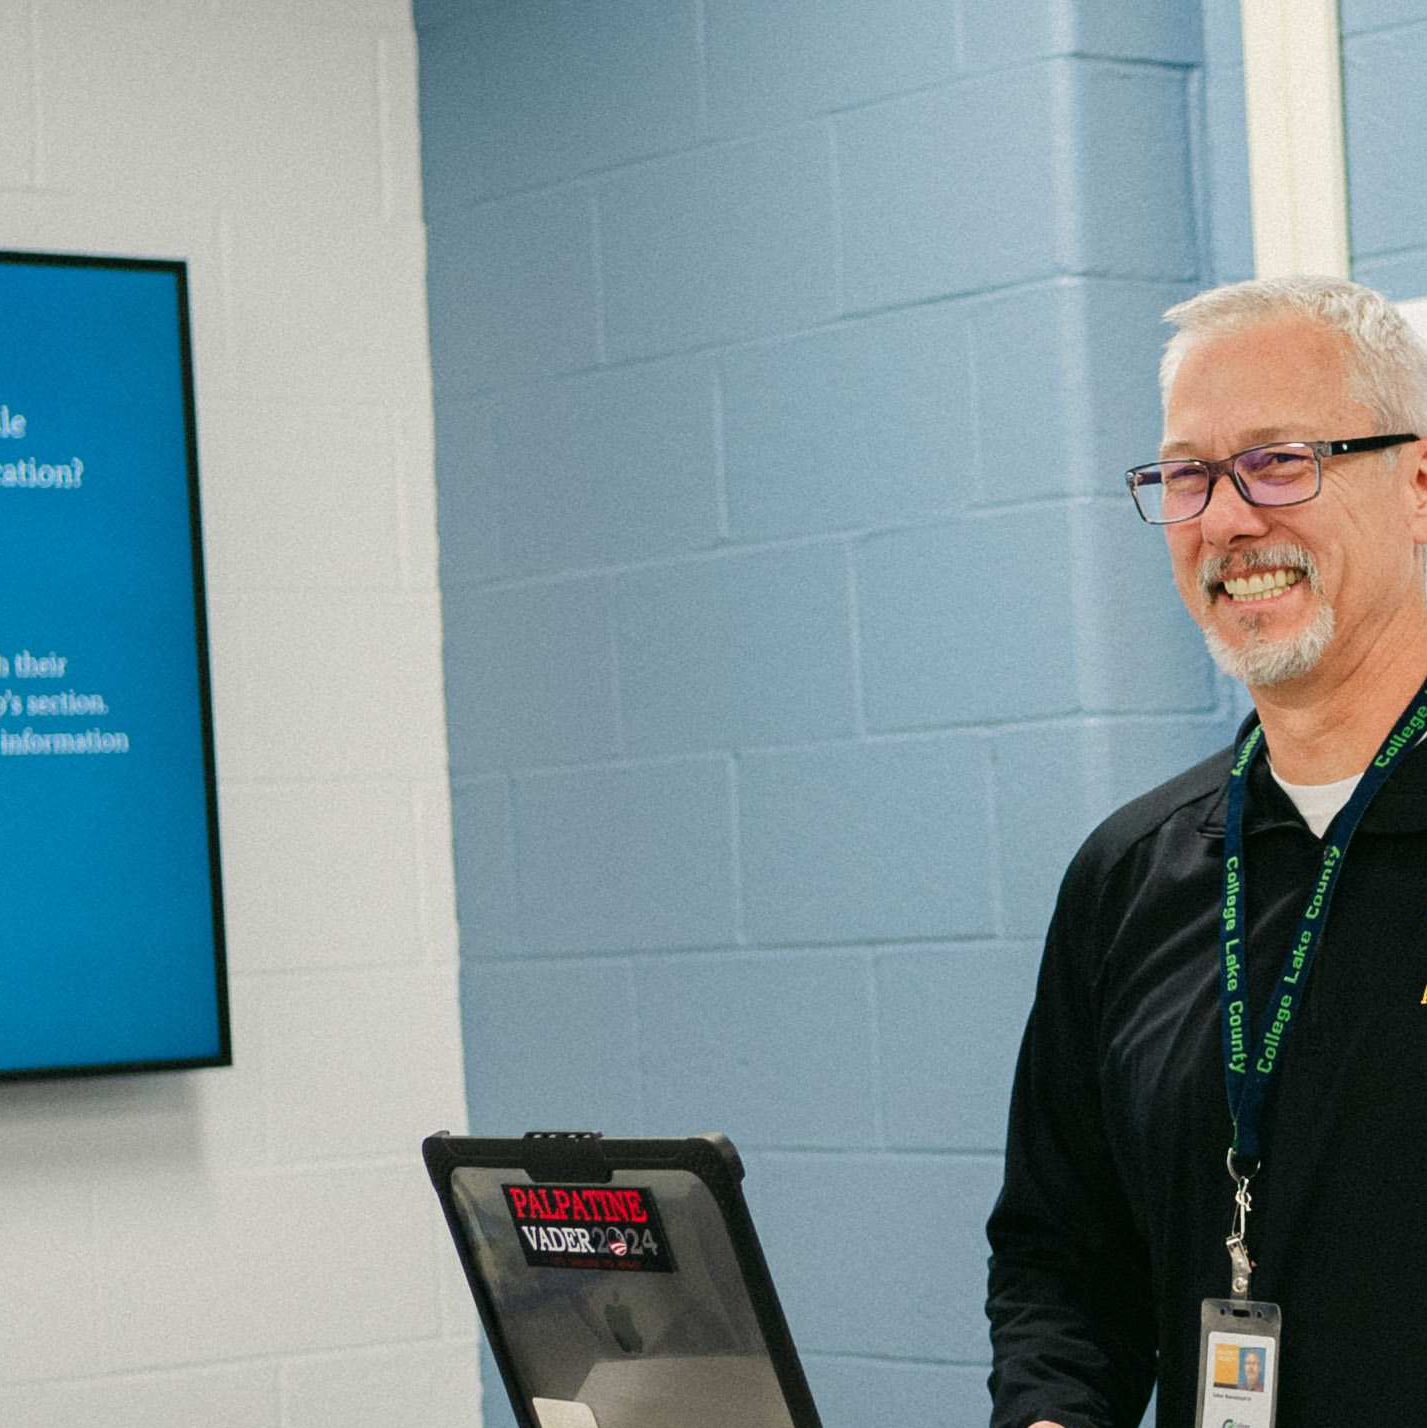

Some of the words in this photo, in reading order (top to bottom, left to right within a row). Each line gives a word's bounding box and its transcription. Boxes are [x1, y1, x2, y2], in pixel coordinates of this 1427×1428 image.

[14, 649, 68, 678] their
[27, 689, 108, 715] section.
[0, 728, 130, 756] information
[1223, 856, 1240, 931] College
[1225, 938, 1241, 991] Lake
[1256, 995, 1292, 1073] College
[1283, 931, 1312, 984] Lake
[1305, 845, 1341, 919] County
[1228, 1001, 1247, 1073] County
[509, 1187, 648, 1223] PALPATINE
